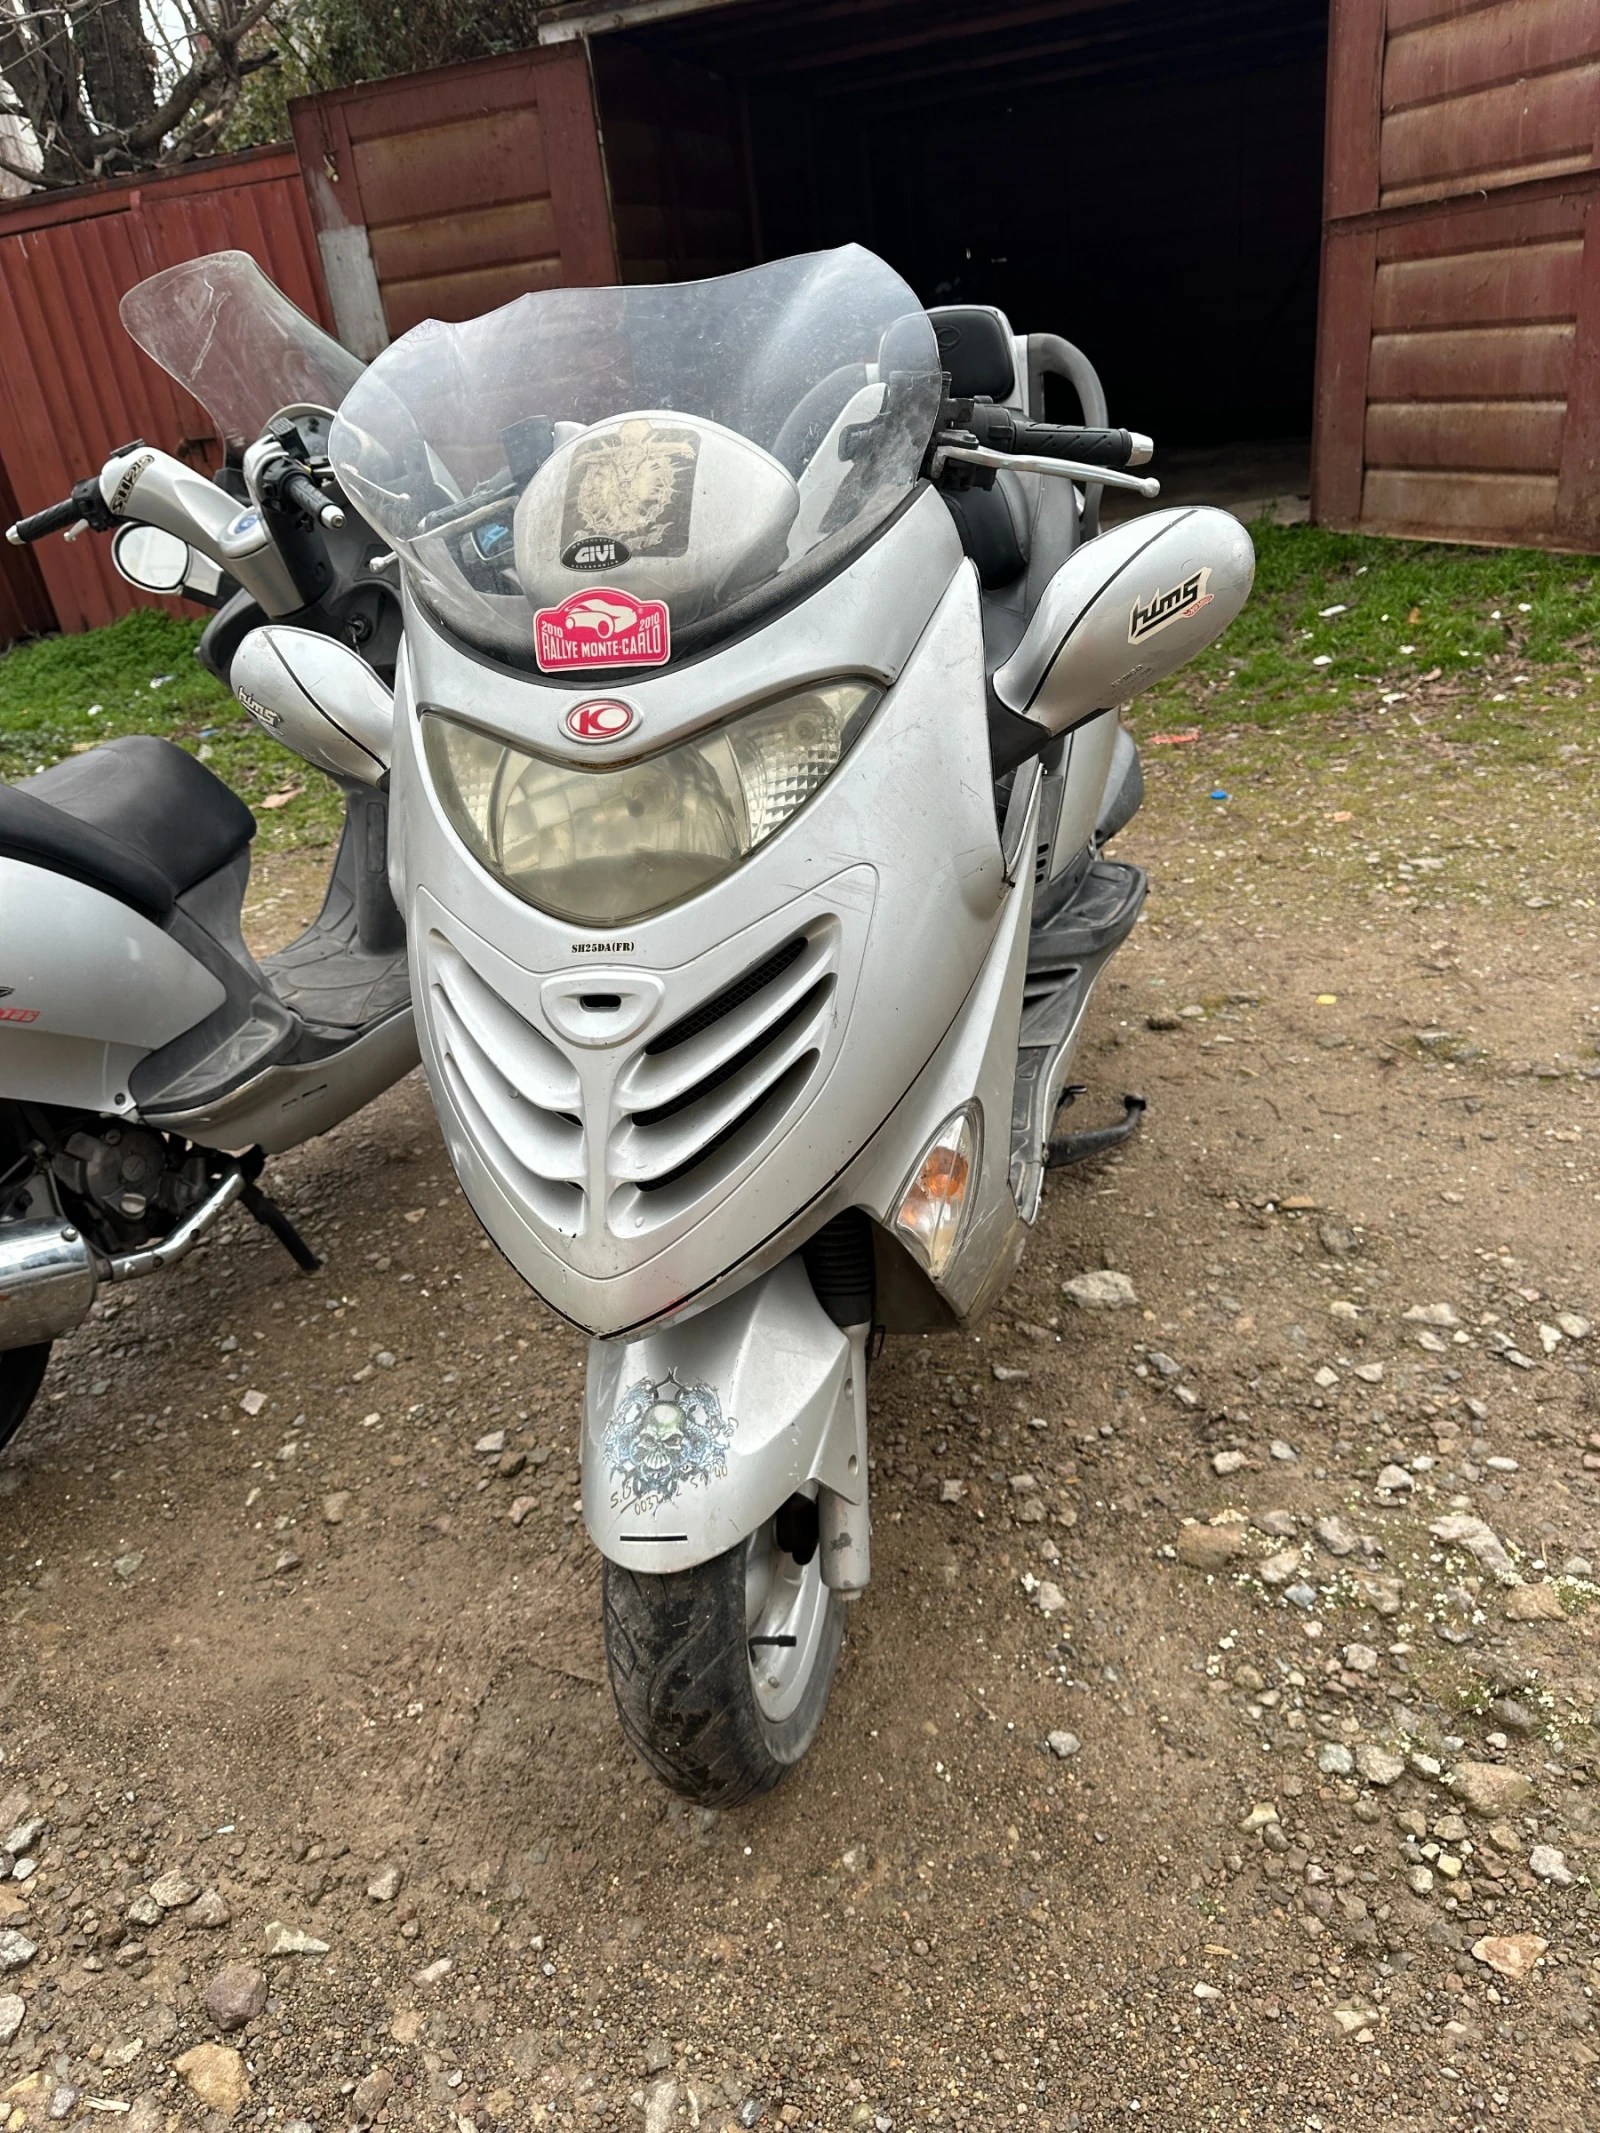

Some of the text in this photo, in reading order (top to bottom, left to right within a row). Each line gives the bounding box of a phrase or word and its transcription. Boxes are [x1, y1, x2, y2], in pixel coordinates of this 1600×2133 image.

[575, 544, 616, 563] GIVI
[541, 620, 563, 638] 2010
[638, 611, 660, 632] 2010
[542, 624, 661, 661] RALLYE MONTE-CARLO
[571, 941, 635, 953] SH25DA(FR)
